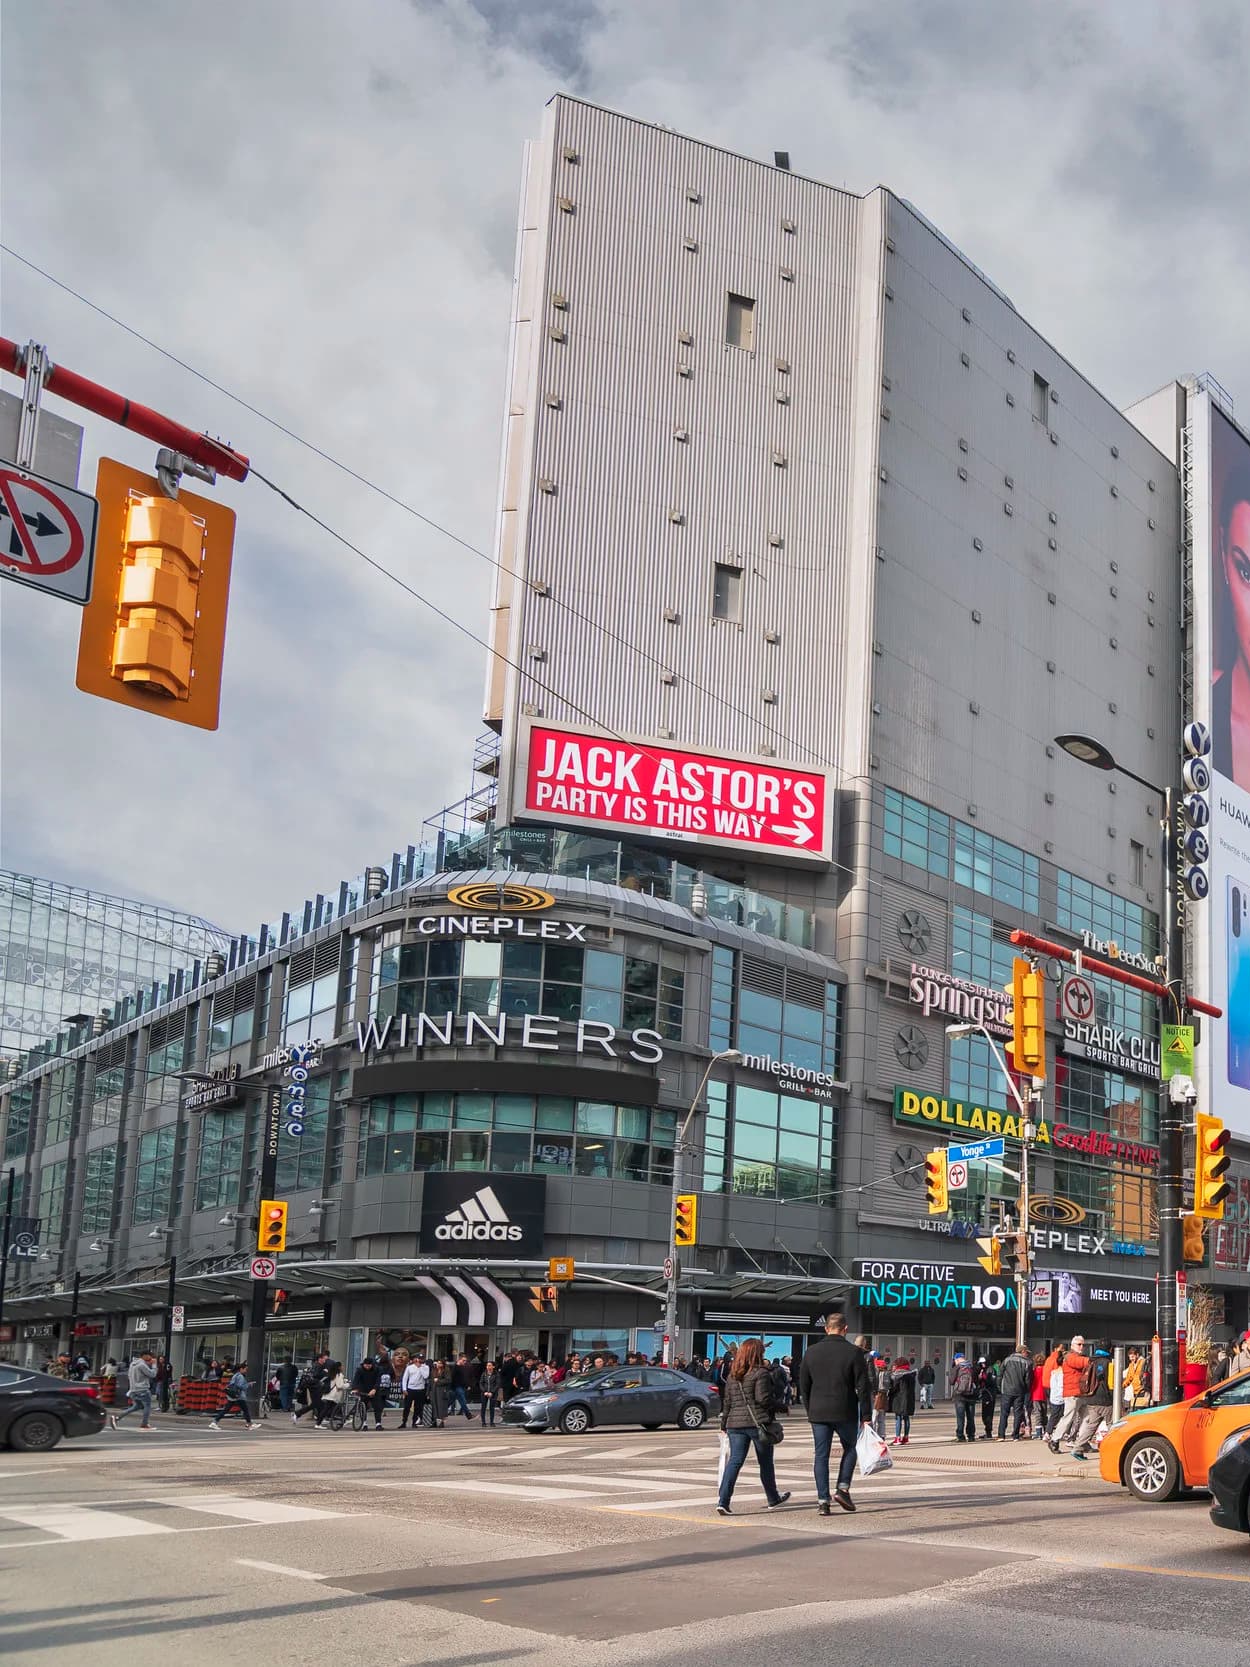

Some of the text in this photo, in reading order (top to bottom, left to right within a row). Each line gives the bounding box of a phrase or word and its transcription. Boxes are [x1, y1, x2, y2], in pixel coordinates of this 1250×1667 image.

[536, 737, 817, 822] JACK ASTOR'S
[535, 781, 766, 840] PARTY IS THIS WAY
[1176, 801, 1185, 928] DOWNTOWN
[1241, 849, 1250, 864] the
[418, 915, 587, 942] CINEPLEX
[356, 1010, 664, 1064] WINNERS
[1064, 1019, 1160, 1065] SHARK CLU
[1165, 1027, 1190, 1036] NOTICE
[1086, 1045, 1117, 1065] SPORTS
[1120, 1055, 1135, 1068] BAR
[742, 1053, 834, 1087] milestones
[779, 1079, 832, 1099] GRILL BAR
[269, 1091, 281, 1156] DOWNTOWN
[960, 1145, 985, 1158] Yonge
[1116, 1142, 1160, 1168] FITNES
[434, 1219, 523, 1241] adidas
[918, 1218, 950, 1233] ULTRA
[992, 1223, 1106, 1256] CEPLEX
[1112, 1241, 1147, 1257] IMAX
[861, 1262, 955, 1281] FOR ACTIVE
[1090, 1288, 1114, 1302] MEET
[1115, 1289, 1131, 1303] YOU
